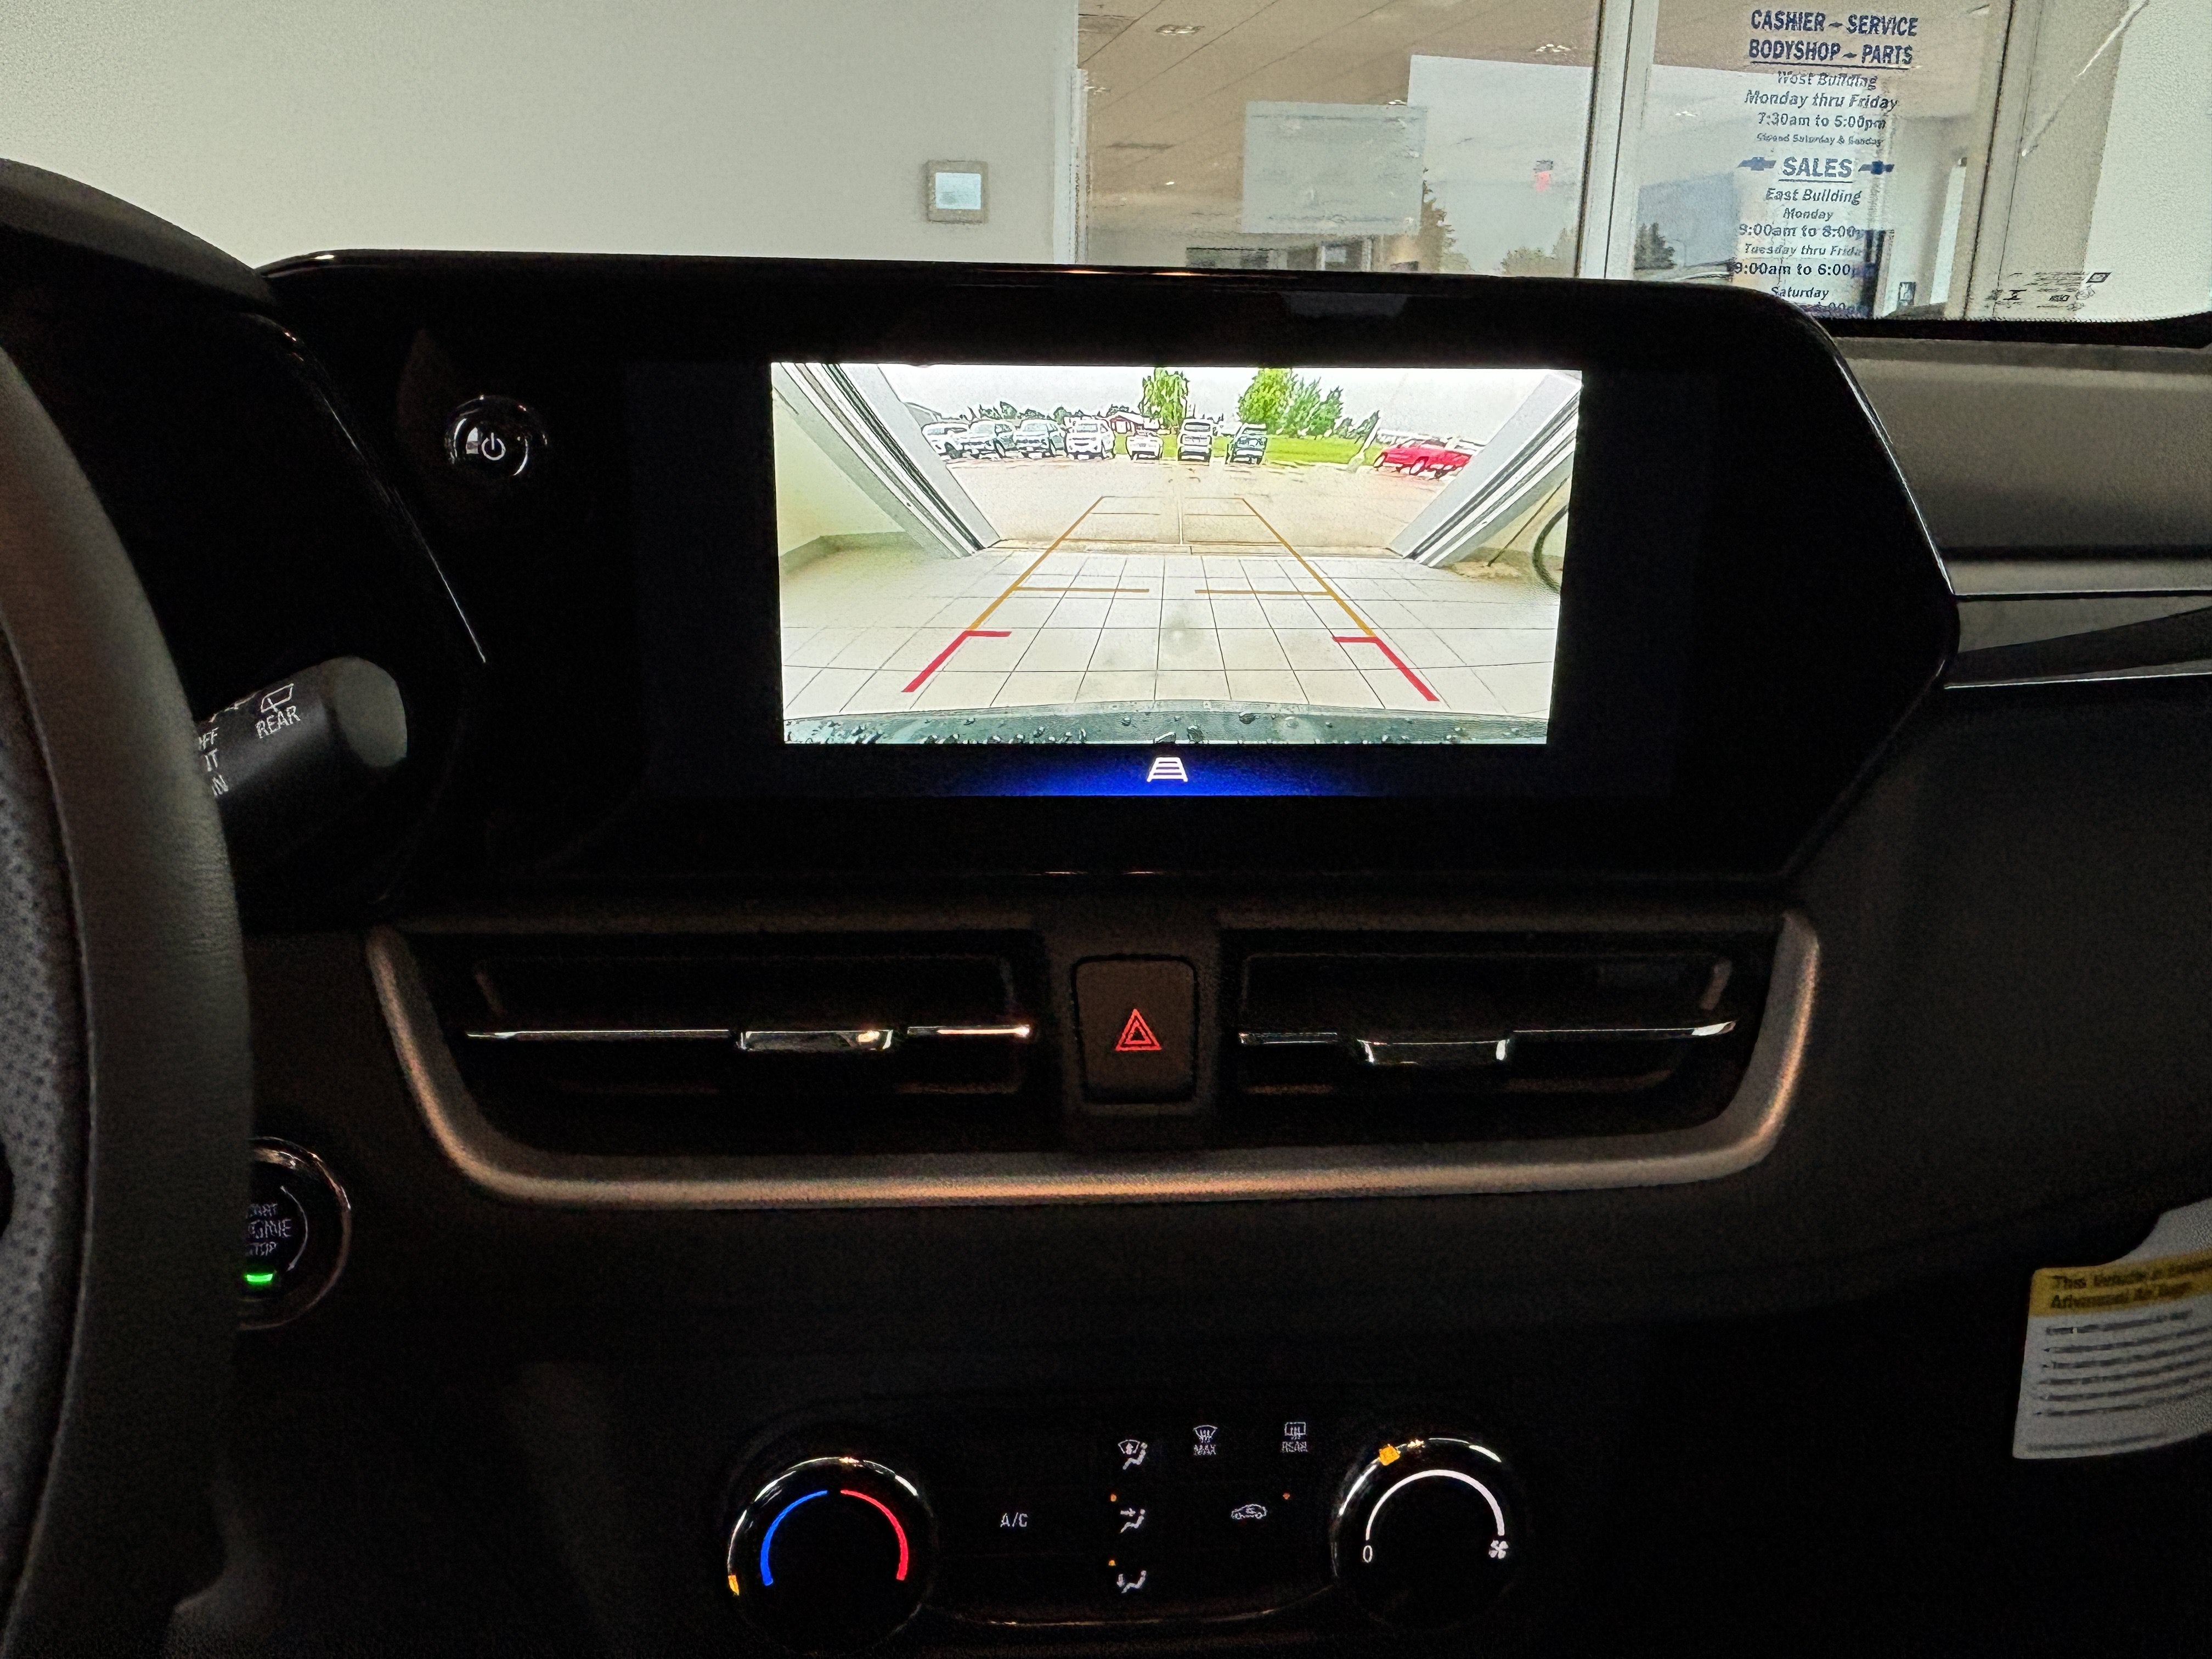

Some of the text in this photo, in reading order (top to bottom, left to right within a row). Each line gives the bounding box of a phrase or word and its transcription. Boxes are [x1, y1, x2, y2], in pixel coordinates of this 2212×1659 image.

[1751, 9, 1918, 36] CASHIER SERVICE
[1748, 39, 1913, 65] BODYSHOP PARTS
[1816, 72, 1878, 91] Building
[1744, 89, 1898, 112] Monday thru Friday
[1757, 112, 1886, 131] 7:30am to 5:00pm
[1782, 156, 1853, 178] SALES
[1765, 188, 1862, 206] East Building
[1783, 208, 1834, 222] Monday
[1739, 223, 1796, 238] 9:00am
[1801, 224, 1817, 237] to
[1745, 242, 1863, 257] Tuesday thru Frida
[1734, 262, 1855, 277] 9:00am to 6:00
[1771, 286, 1830, 300] Saturday
[255, 705, 301, 739] REAR
[1193, 1444, 1216, 1455] MAX
[1281, 1441, 1308, 1453] REAR
[1000, 1511, 1028, 1528] A/C
[1362, 1544, 1373, 1563] 0
